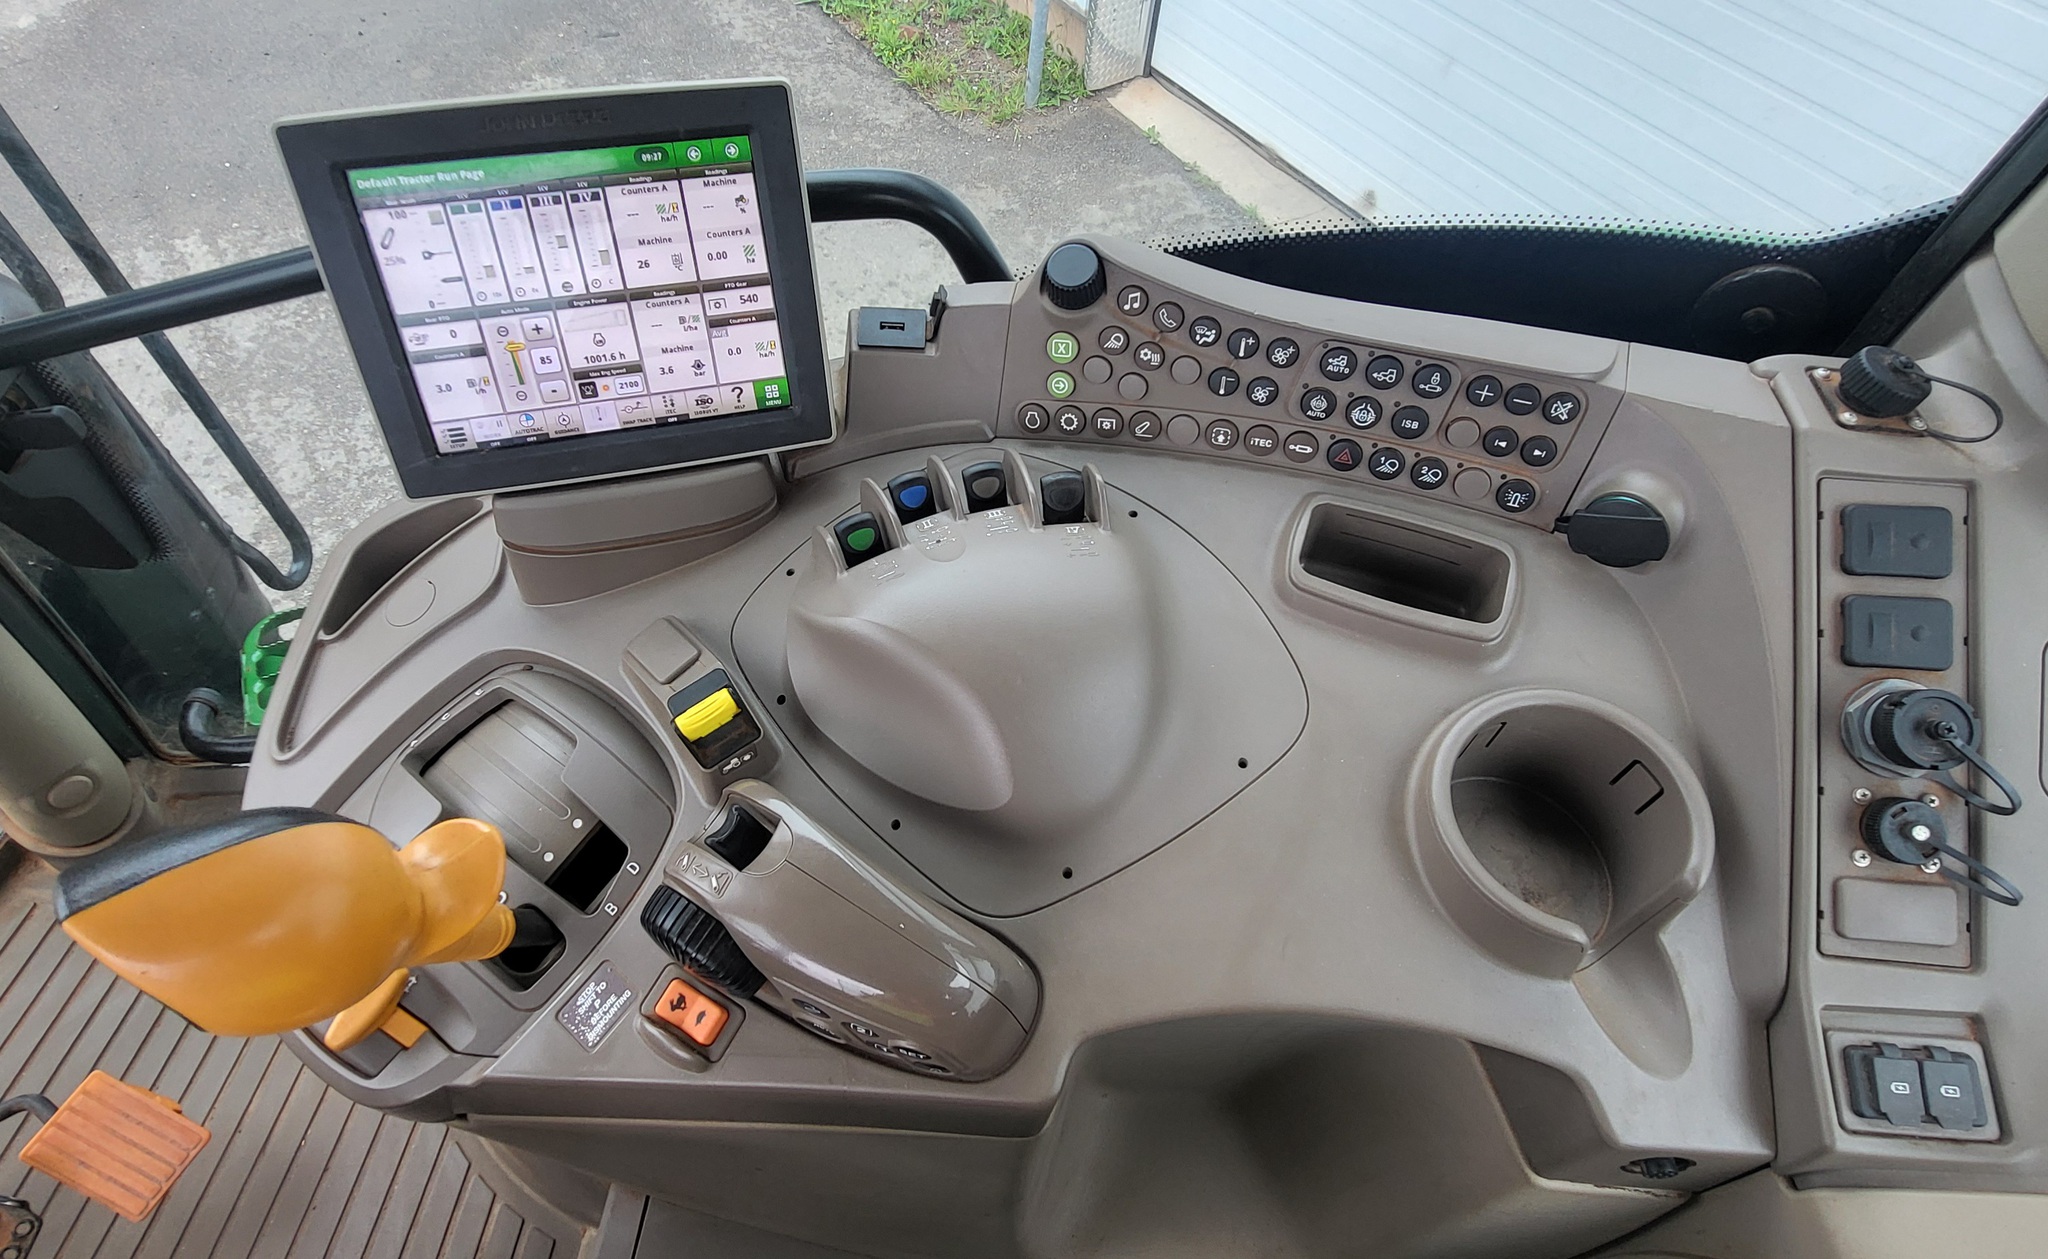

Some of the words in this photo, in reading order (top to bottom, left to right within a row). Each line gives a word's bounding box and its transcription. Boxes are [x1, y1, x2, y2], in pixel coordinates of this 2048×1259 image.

[356, 177, 397, 189] Default
[399, 174, 435, 185] Tractor
[437, 172, 458, 181] Run
[460, 170, 485, 181] Page
[703, 177, 737, 188] Machine
[621, 186, 659, 195] Counters
[662, 184, 668, 192] A
[661, 215, 679, 223] ha/h
[706, 229, 743, 239] Counters
[745, 227, 751, 235] A
[638, 236, 673, 247] Machine
[707, 251, 728, 262] 0.00
[637, 259, 650, 269] 26
[646, 298, 682, 309] Counters
[739, 293, 759, 305] 540
[449, 329, 457, 339] 0
[661, 345, 694, 355] Machine
[727, 347, 742, 356] 0.0
[540, 356, 553, 365] 85
[584, 353, 617, 364] 1001.6
[618, 351, 626, 360] h
[659, 366, 674, 376] 3.6
[1326, 364, 1350, 374] AUTO
[435, 383, 452, 393] 3.0
[618, 381, 639, 390] 2100
[694, 397, 714, 406] ISO
[1306, 410, 1326, 419] AUTO
[1401, 419, 1419, 429] ISB
[514, 427, 544, 435] AUTOTRAC
[1250, 437, 1273, 448] iTEC
[626, 862, 640, 875] D
[604, 902, 618, 916] B
[577, 982, 596, 1004] STOP
[578, 992, 597, 1015] SHIFT
[596, 982, 607, 994] TO
[594, 999, 601, 1010] P
[587, 990, 631, 1041] DISMOUNTING
